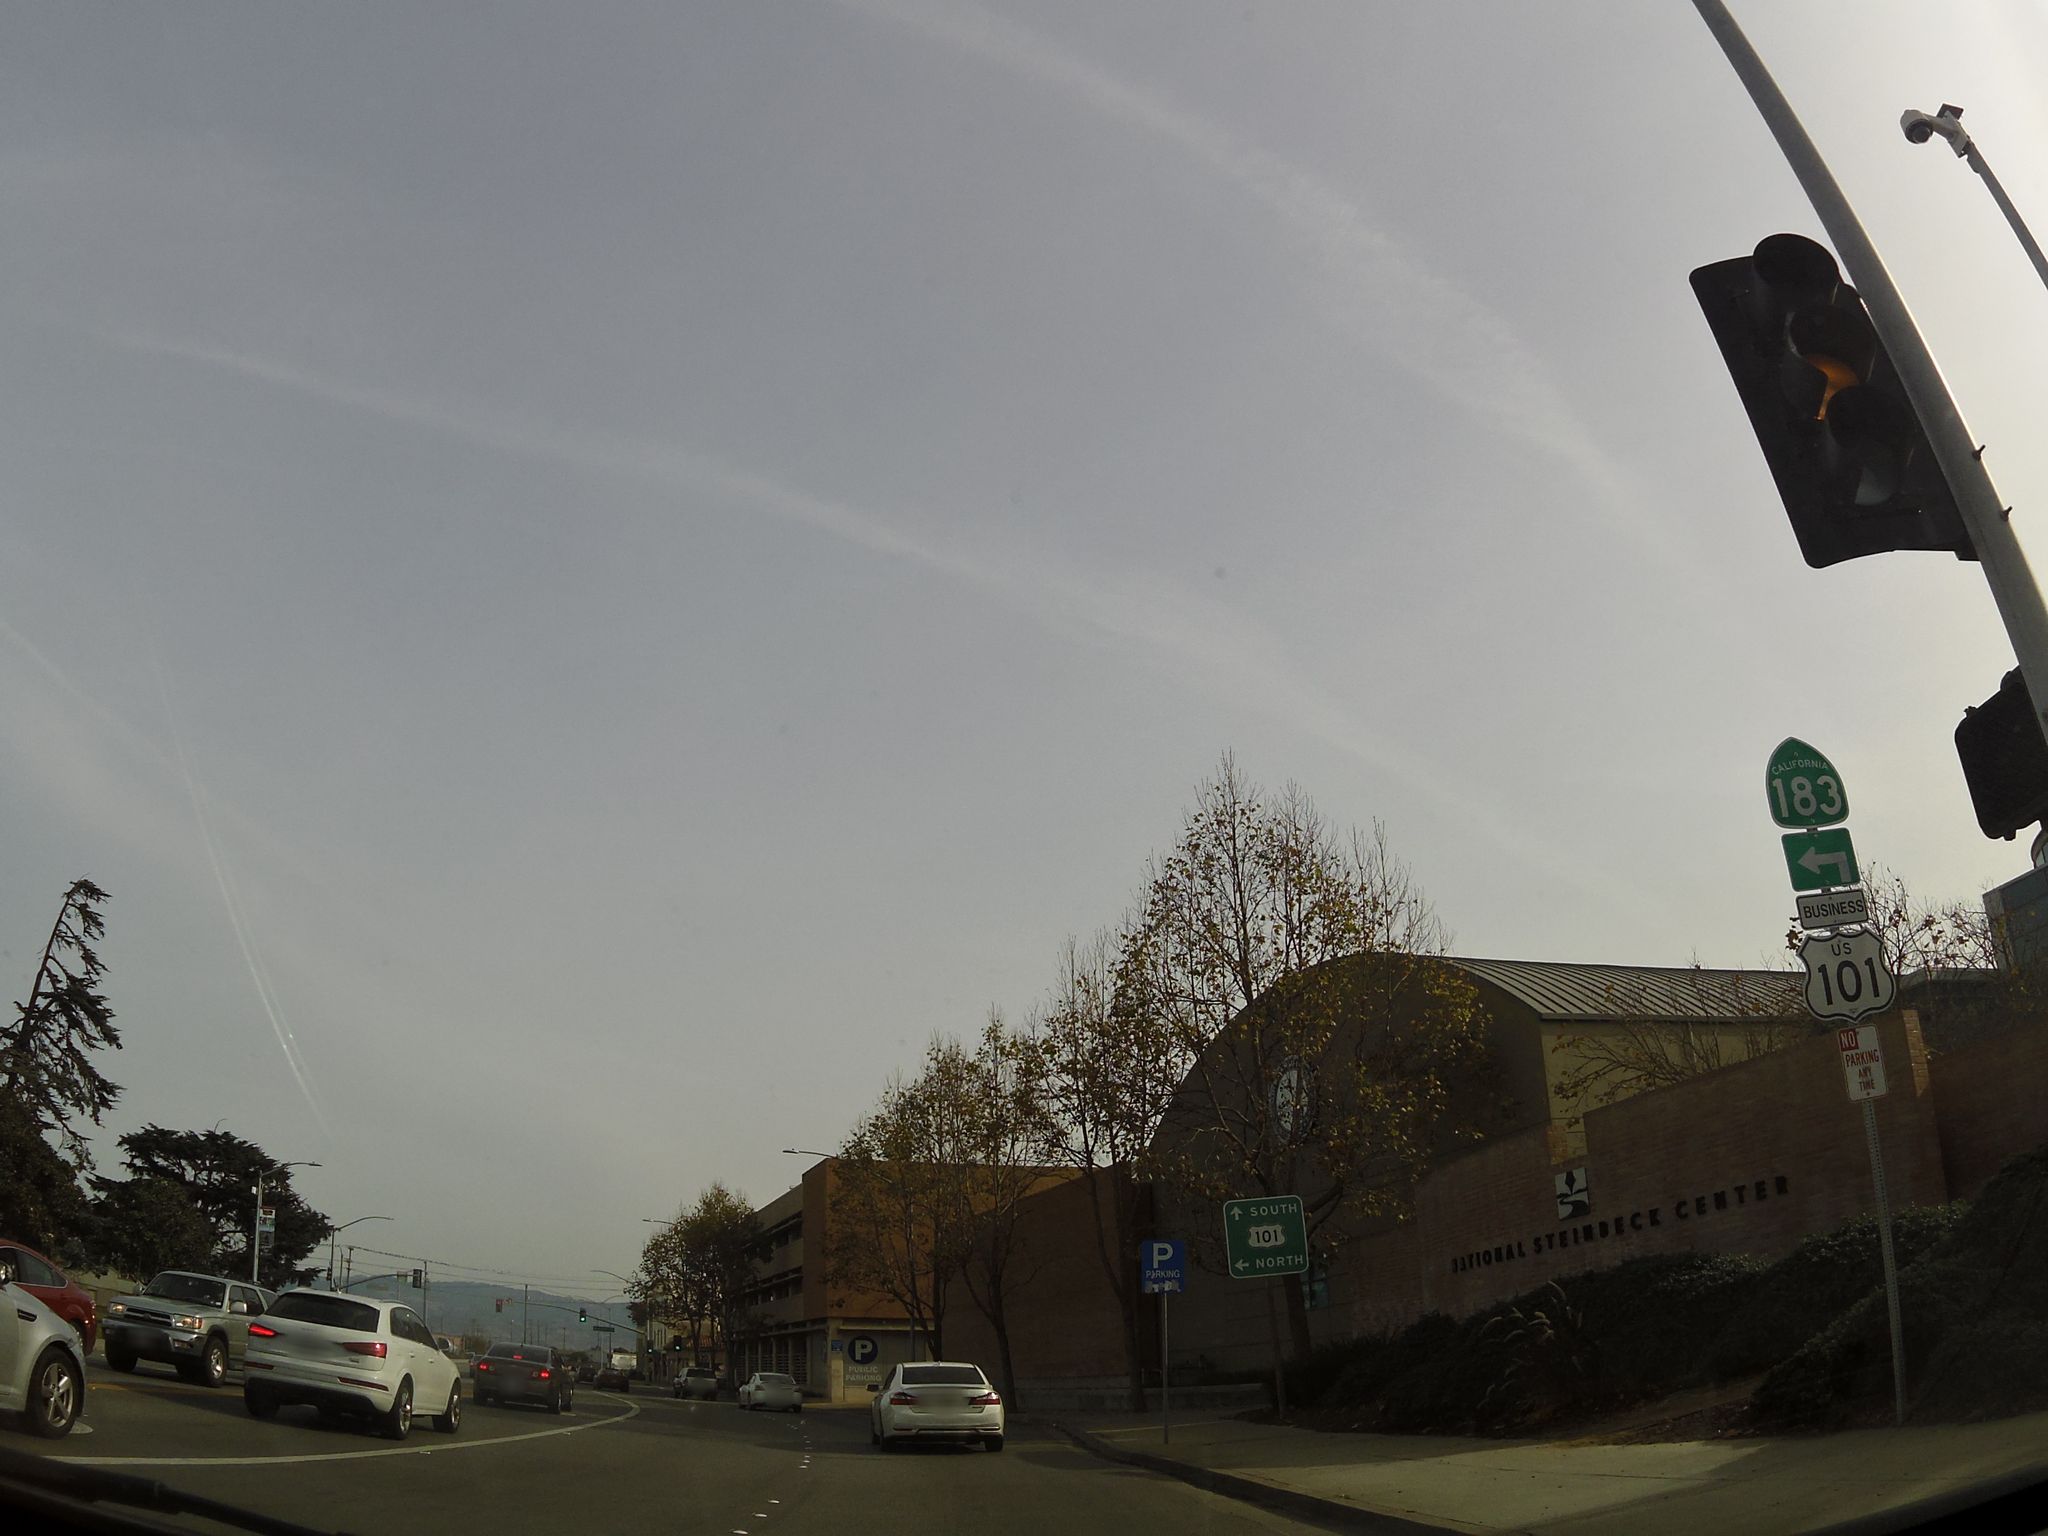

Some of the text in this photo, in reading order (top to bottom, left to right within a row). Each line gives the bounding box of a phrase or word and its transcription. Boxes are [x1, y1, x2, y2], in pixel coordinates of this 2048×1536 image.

[1772, 760, 1830, 775] CALIFORNIA
[1772, 775, 1843, 818] 183
[1803, 898, 1864, 919] BUSINESS
[1831, 942, 1852, 956] US
[1817, 957, 1881, 1006] 101
[1840, 1031, 1857, 1049] NO
[1845, 1049, 1880, 1068] PARKING
[1858, 1067, 1873, 1079] ANY
[1859, 1078, 1876, 1092] TIME
[1250, 1203, 1298, 1217] SOUTH
[1533, 1207, 1662, 1255] STEINBECK
[1675, 1175, 1790, 1220] CENTER
[1255, 1229, 1279, 1243] 101
[1152, 1243, 1174, 1269] P
[1255, 1255, 1304, 1268] NORTH
[1145, 1270, 1181, 1279] PARKING
[855, 1339, 873, 1361] P
